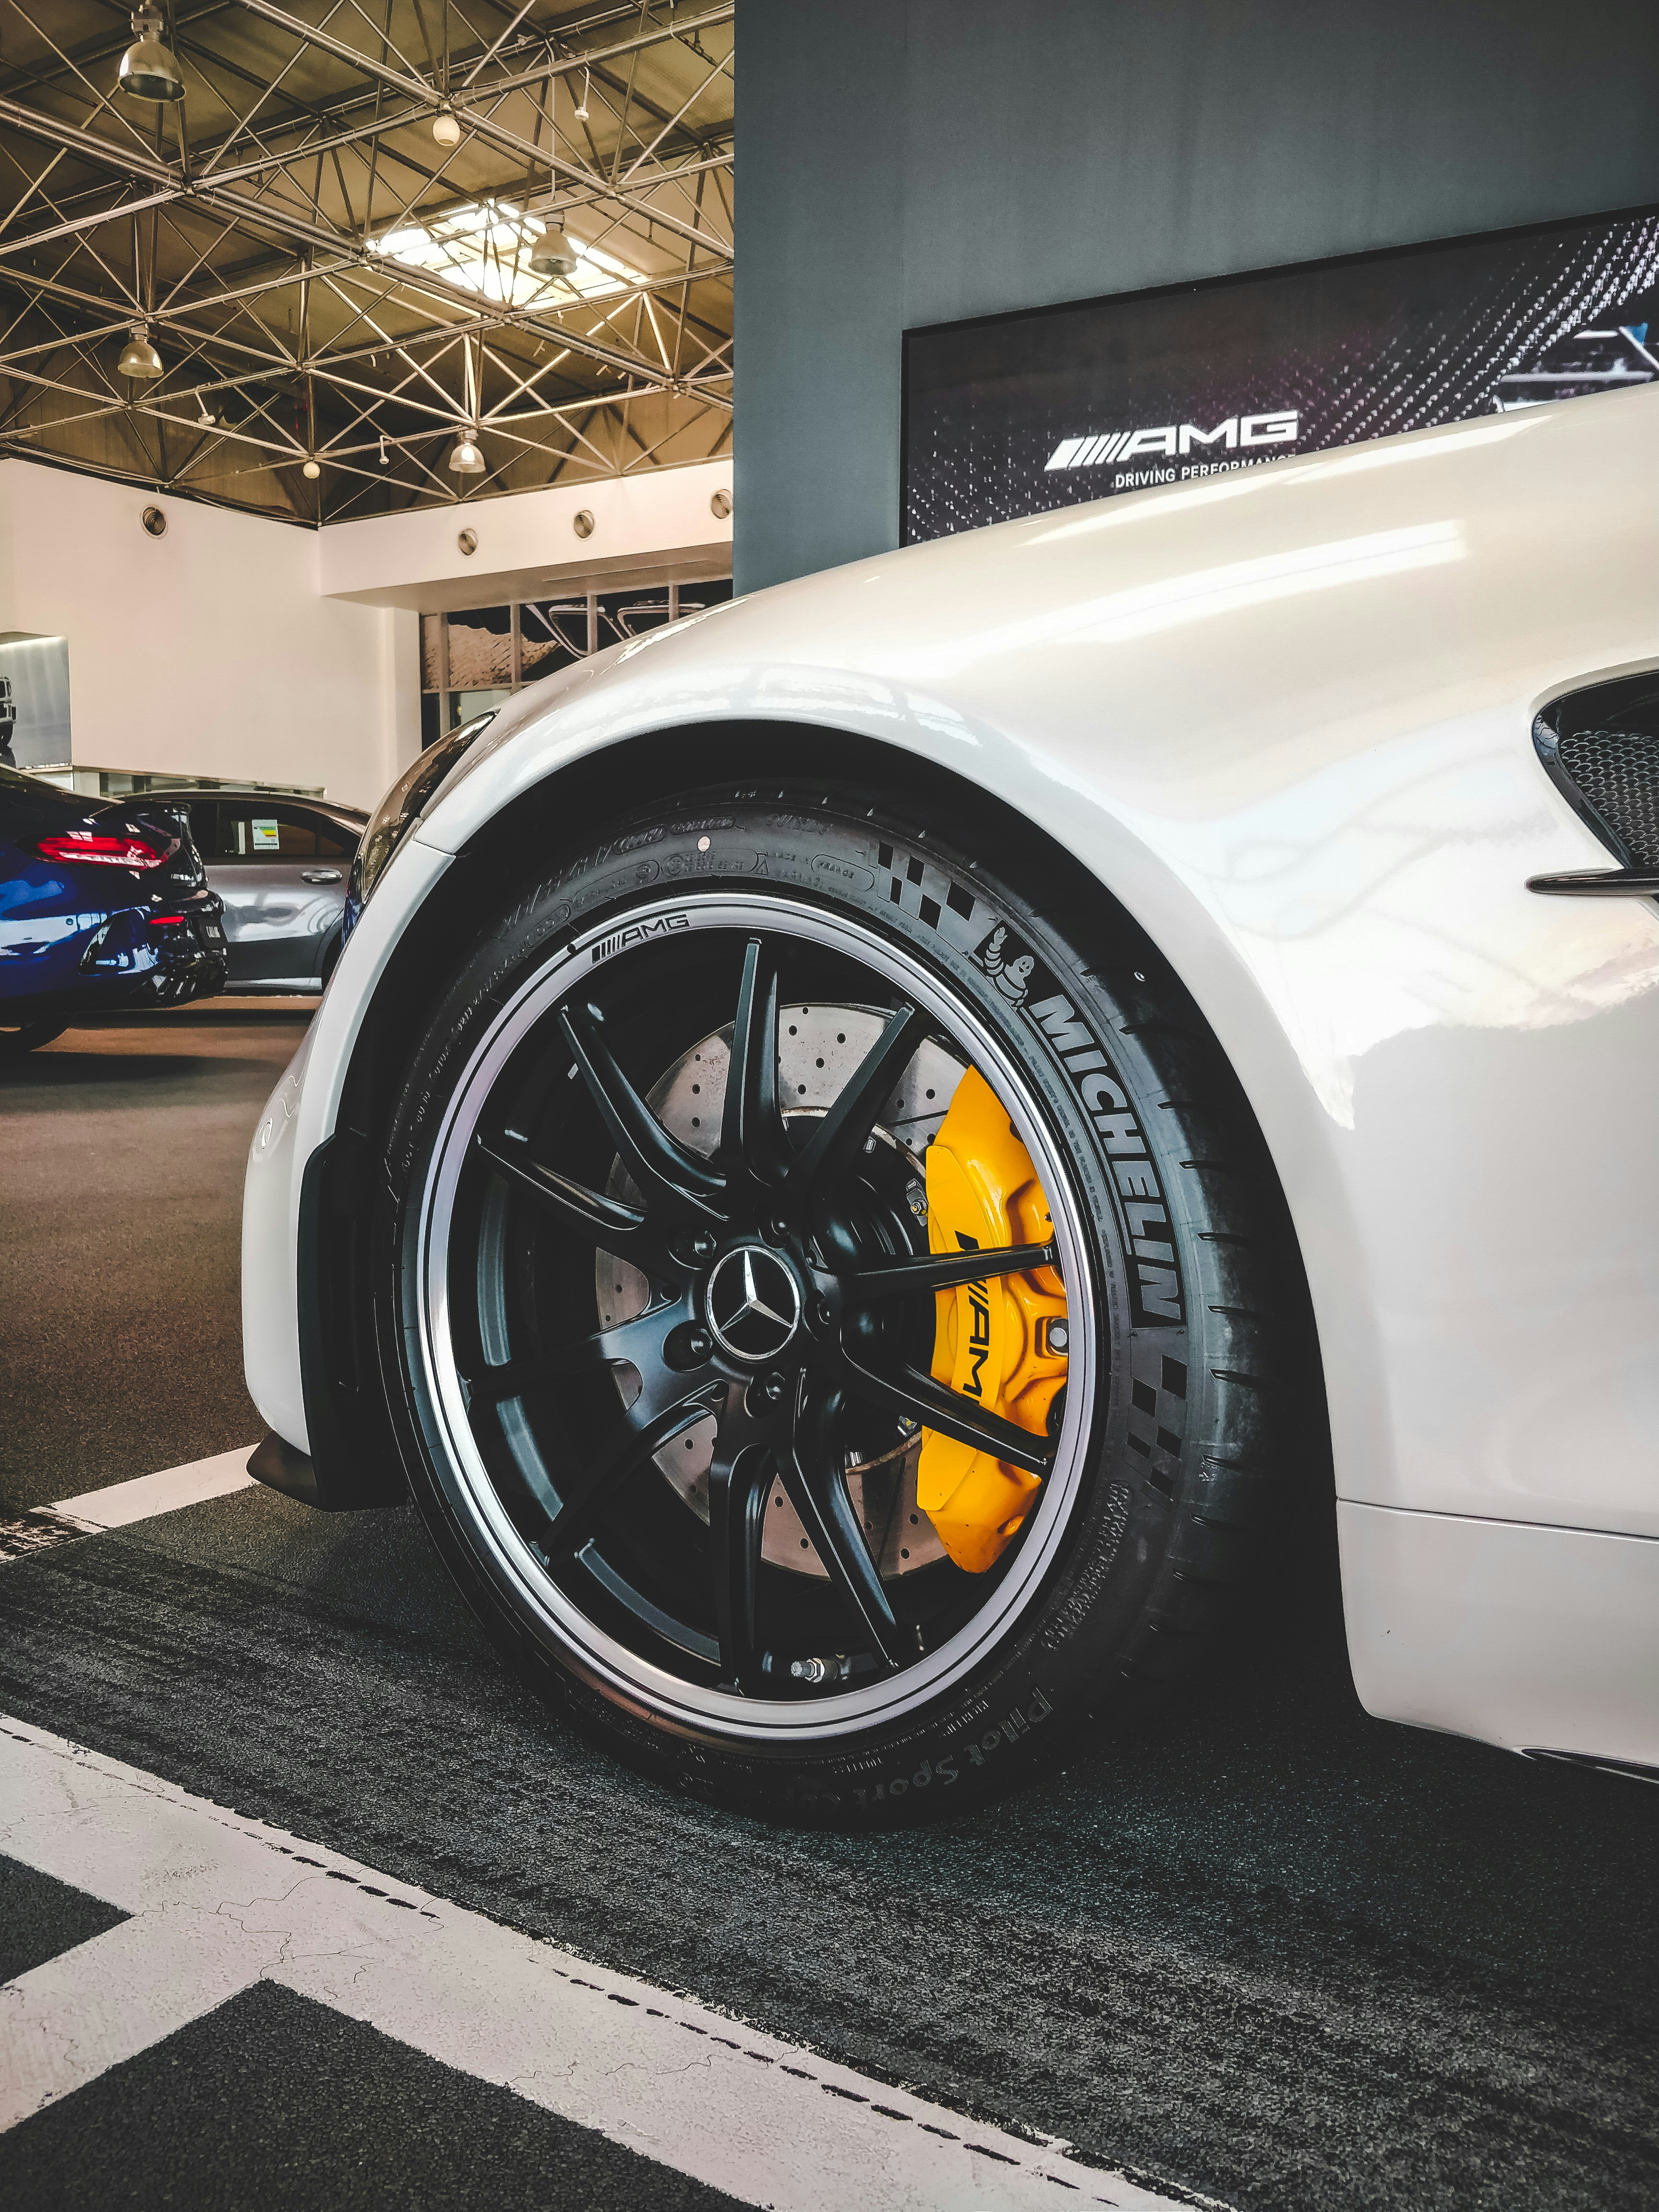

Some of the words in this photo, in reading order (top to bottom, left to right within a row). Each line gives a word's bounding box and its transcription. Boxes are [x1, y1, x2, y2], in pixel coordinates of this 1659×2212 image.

[1116, 409, 1298, 462] AMG
[1115, 468, 1176, 488] DRIVING
[622, 914, 690, 948] AMG
[1028, 994, 1181, 1320] MICHELIN
[962, 1295, 989, 1403] AM
[963, 1687, 1053, 1766] Pilot
